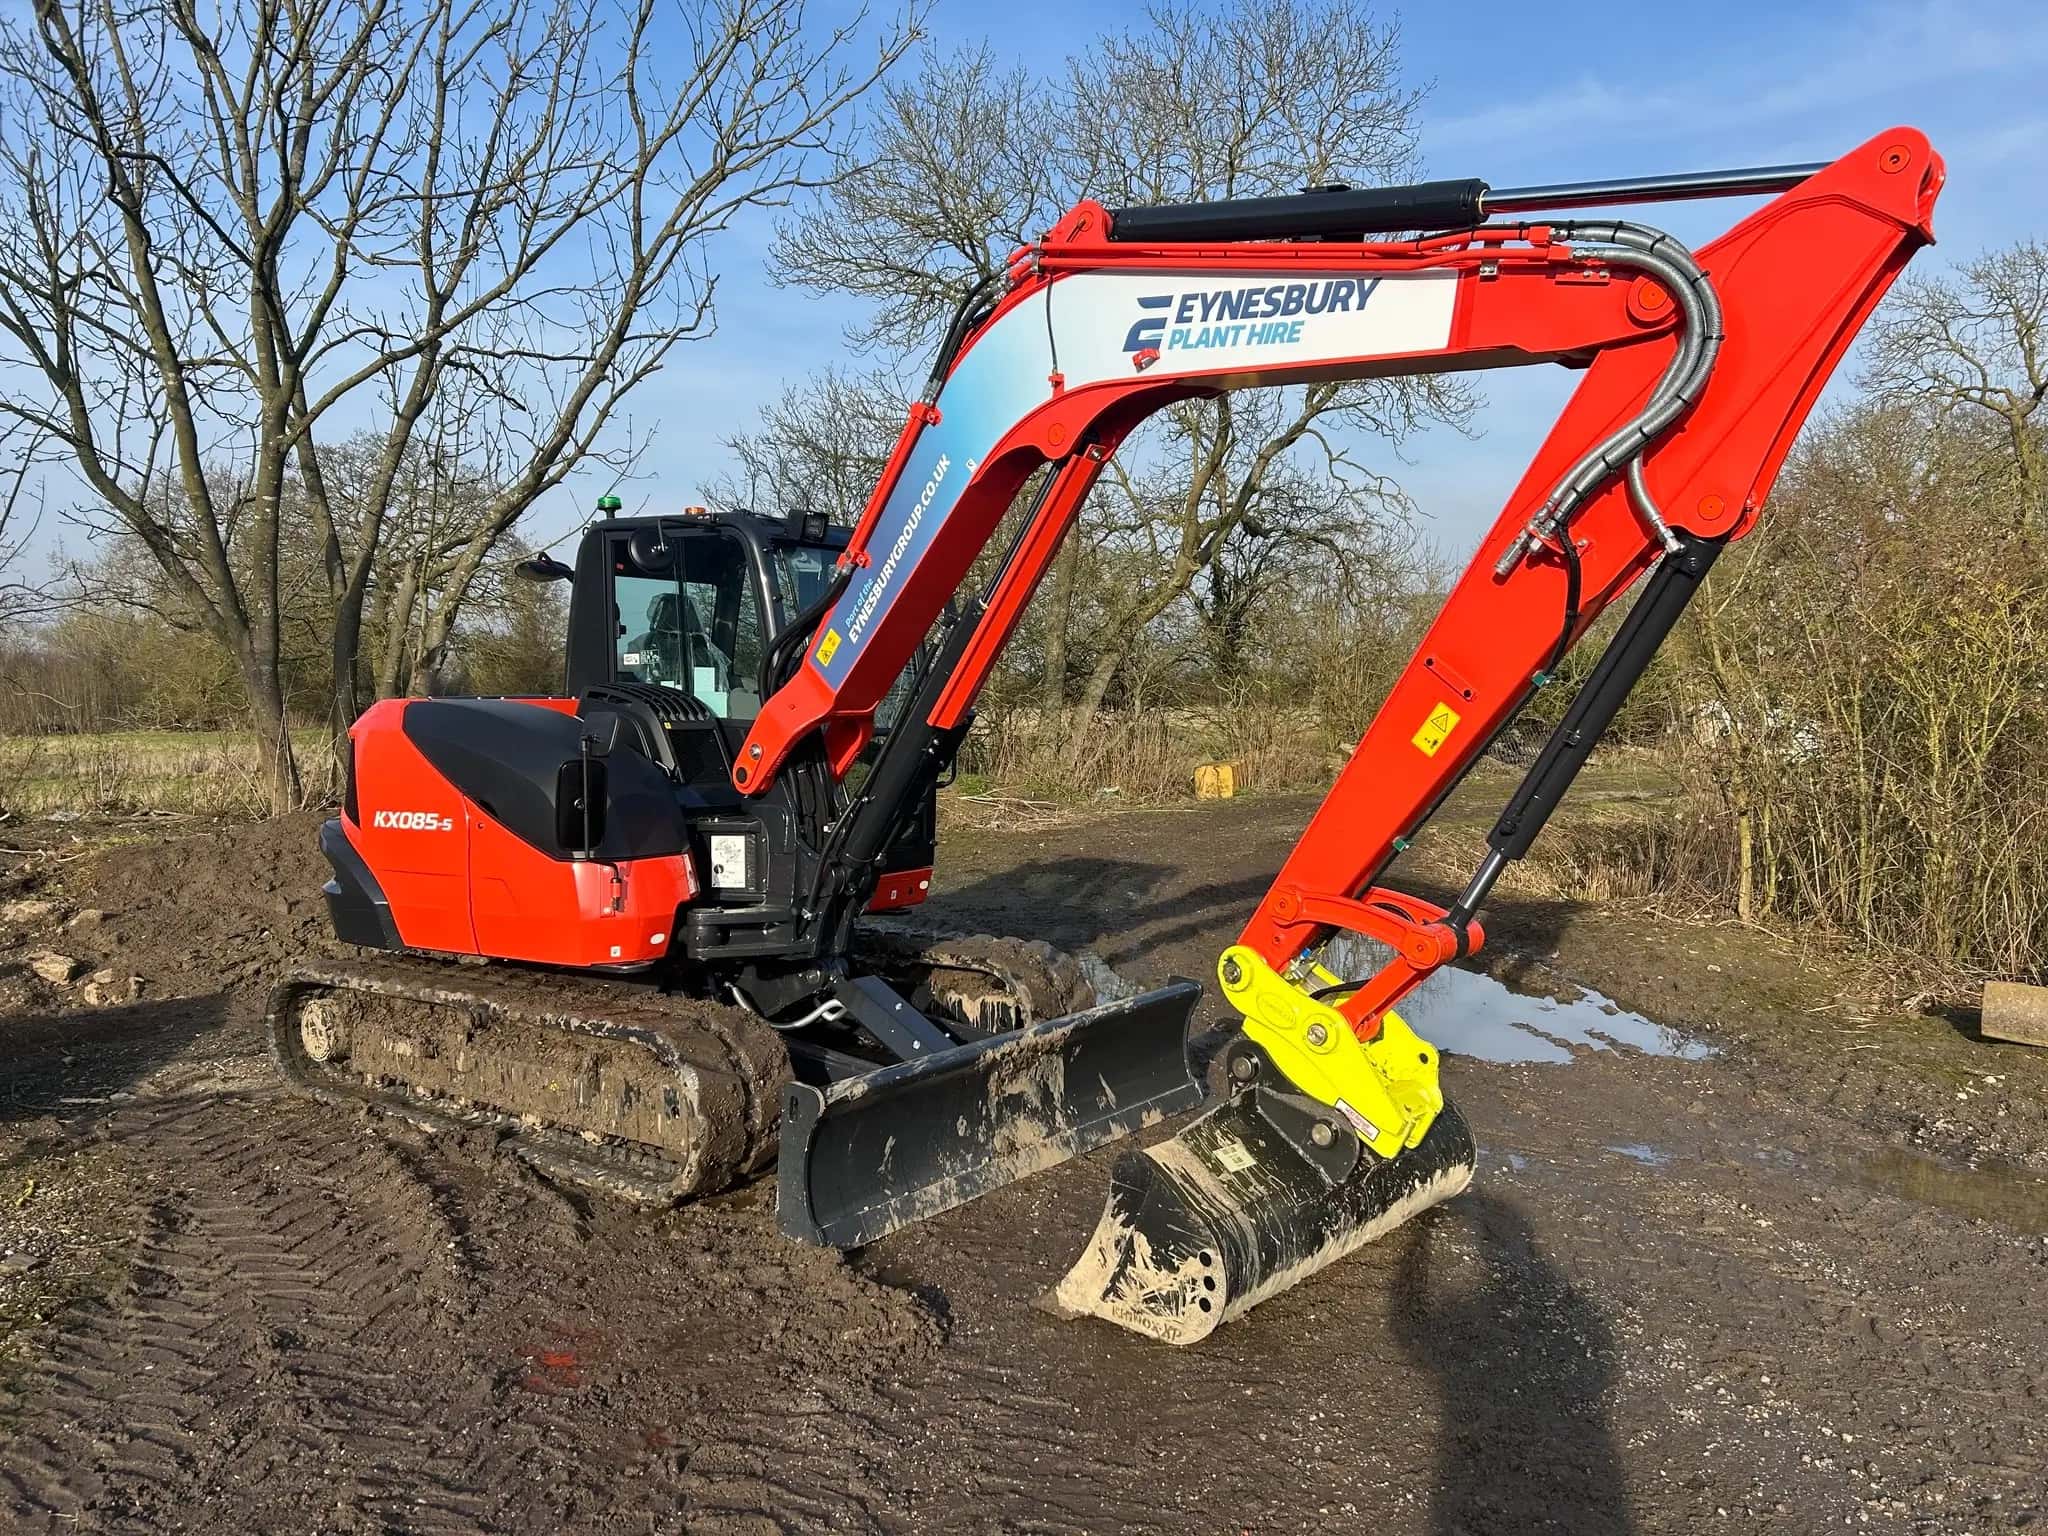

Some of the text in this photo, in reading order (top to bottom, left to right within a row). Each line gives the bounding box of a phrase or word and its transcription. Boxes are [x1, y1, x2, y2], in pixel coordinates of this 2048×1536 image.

[1175, 277, 1383, 324] EYNESBURY
[1168, 320, 1305, 350] PLANT HIRE
[848, 454, 951, 645] EYNESBURYGROUP.CO.UK
[857, 592, 865, 606] of
[862, 578, 873, 595] the
